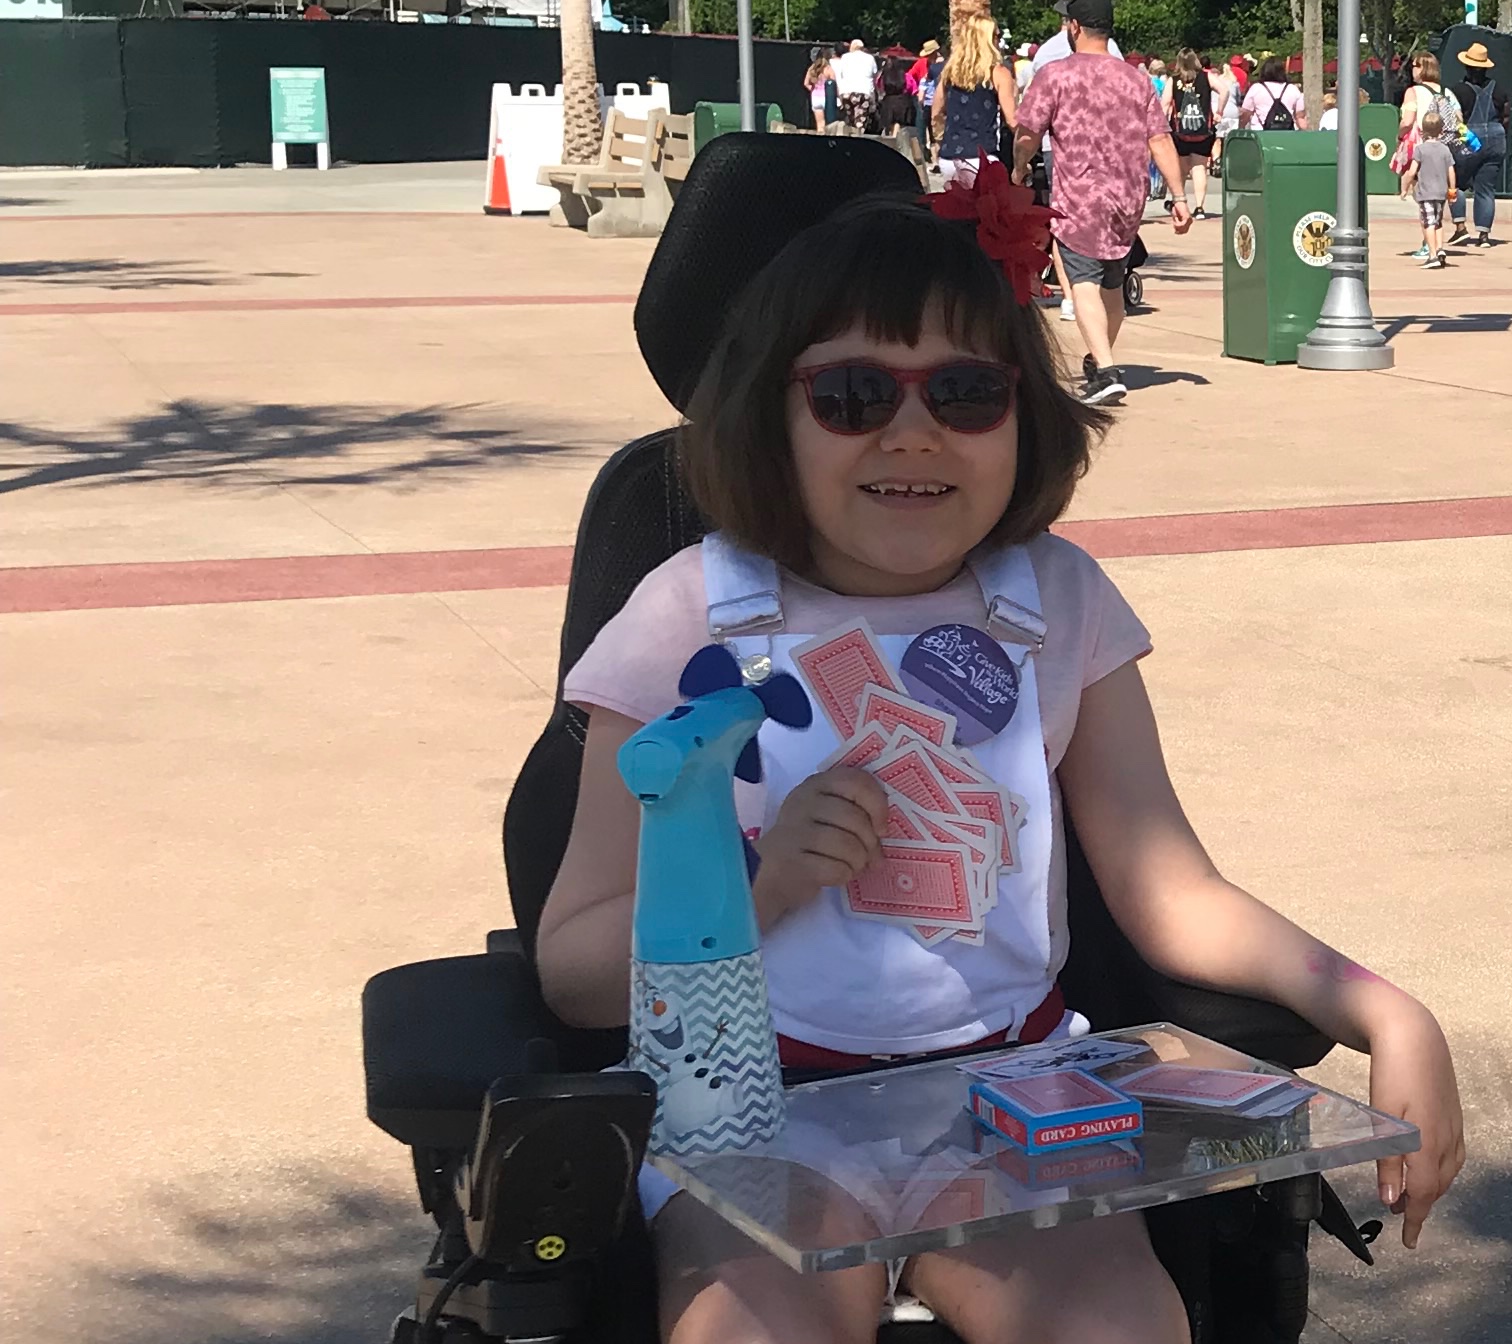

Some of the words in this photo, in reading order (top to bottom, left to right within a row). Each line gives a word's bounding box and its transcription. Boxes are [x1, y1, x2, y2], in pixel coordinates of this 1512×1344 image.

[968, 665, 1008, 704] Village
[1041, 1127, 1076, 1142] CARD
[1081, 1116, 1134, 1135] PLAYING
